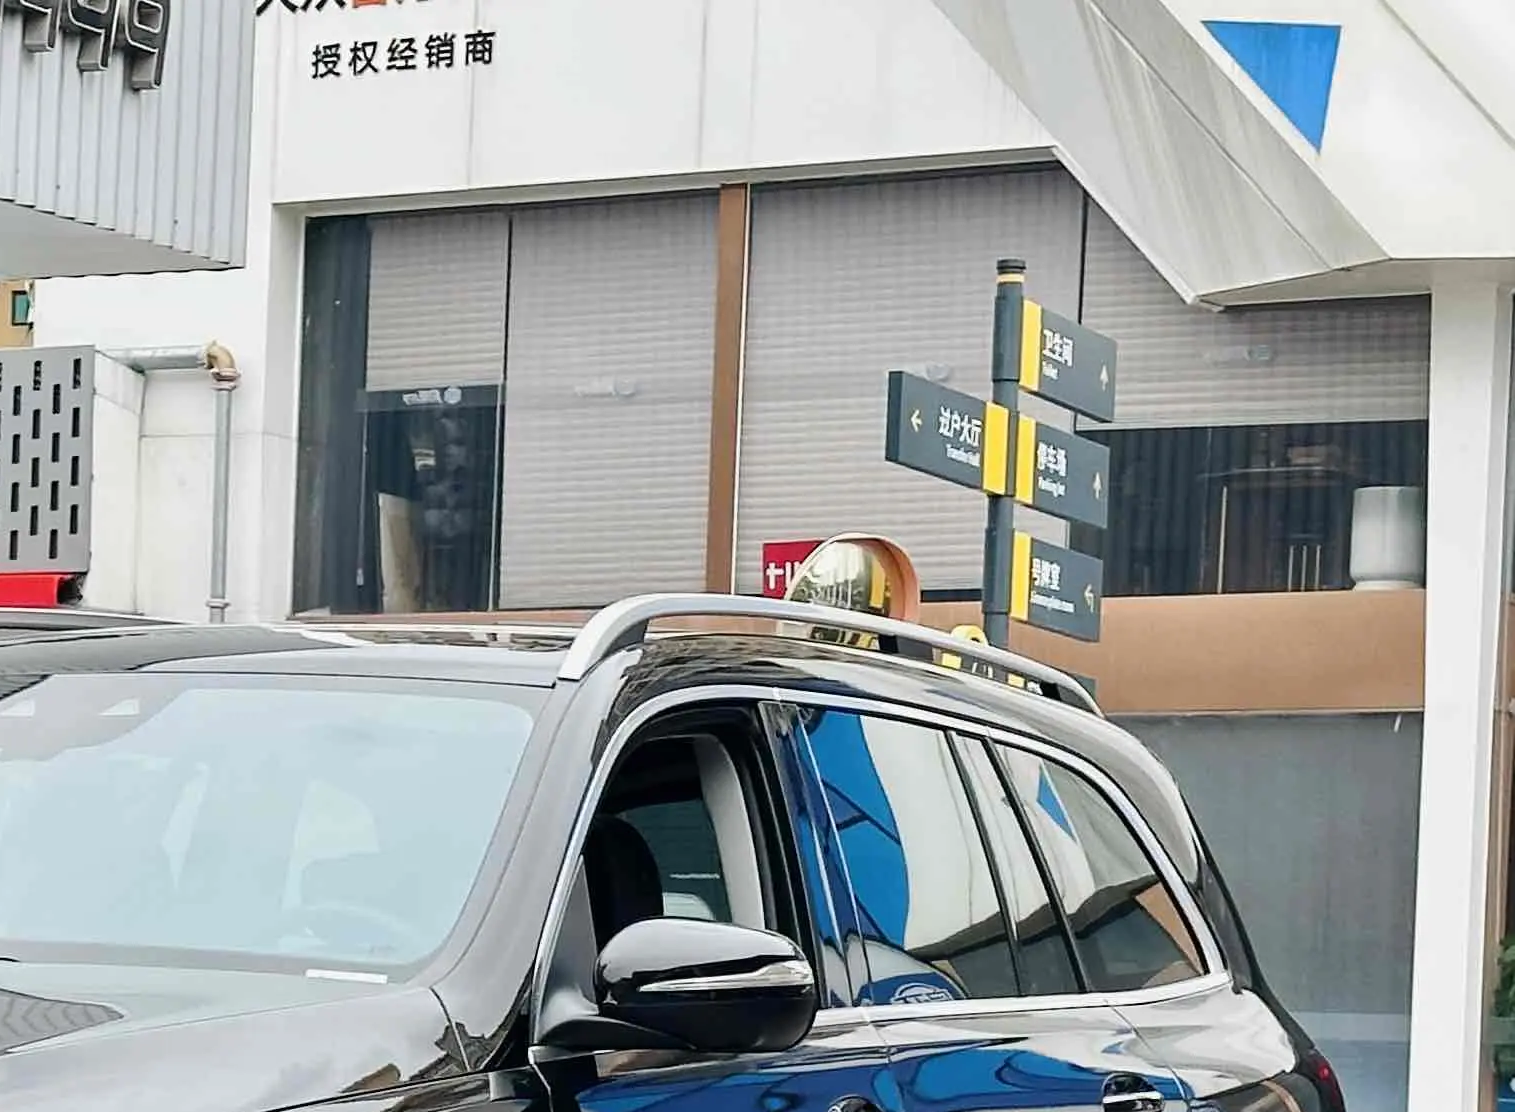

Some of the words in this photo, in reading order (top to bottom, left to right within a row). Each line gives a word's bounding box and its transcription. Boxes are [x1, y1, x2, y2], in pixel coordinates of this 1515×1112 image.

[311, 29, 496, 79] 授权经销商
[1042, 328, 1073, 367] 卫生间
